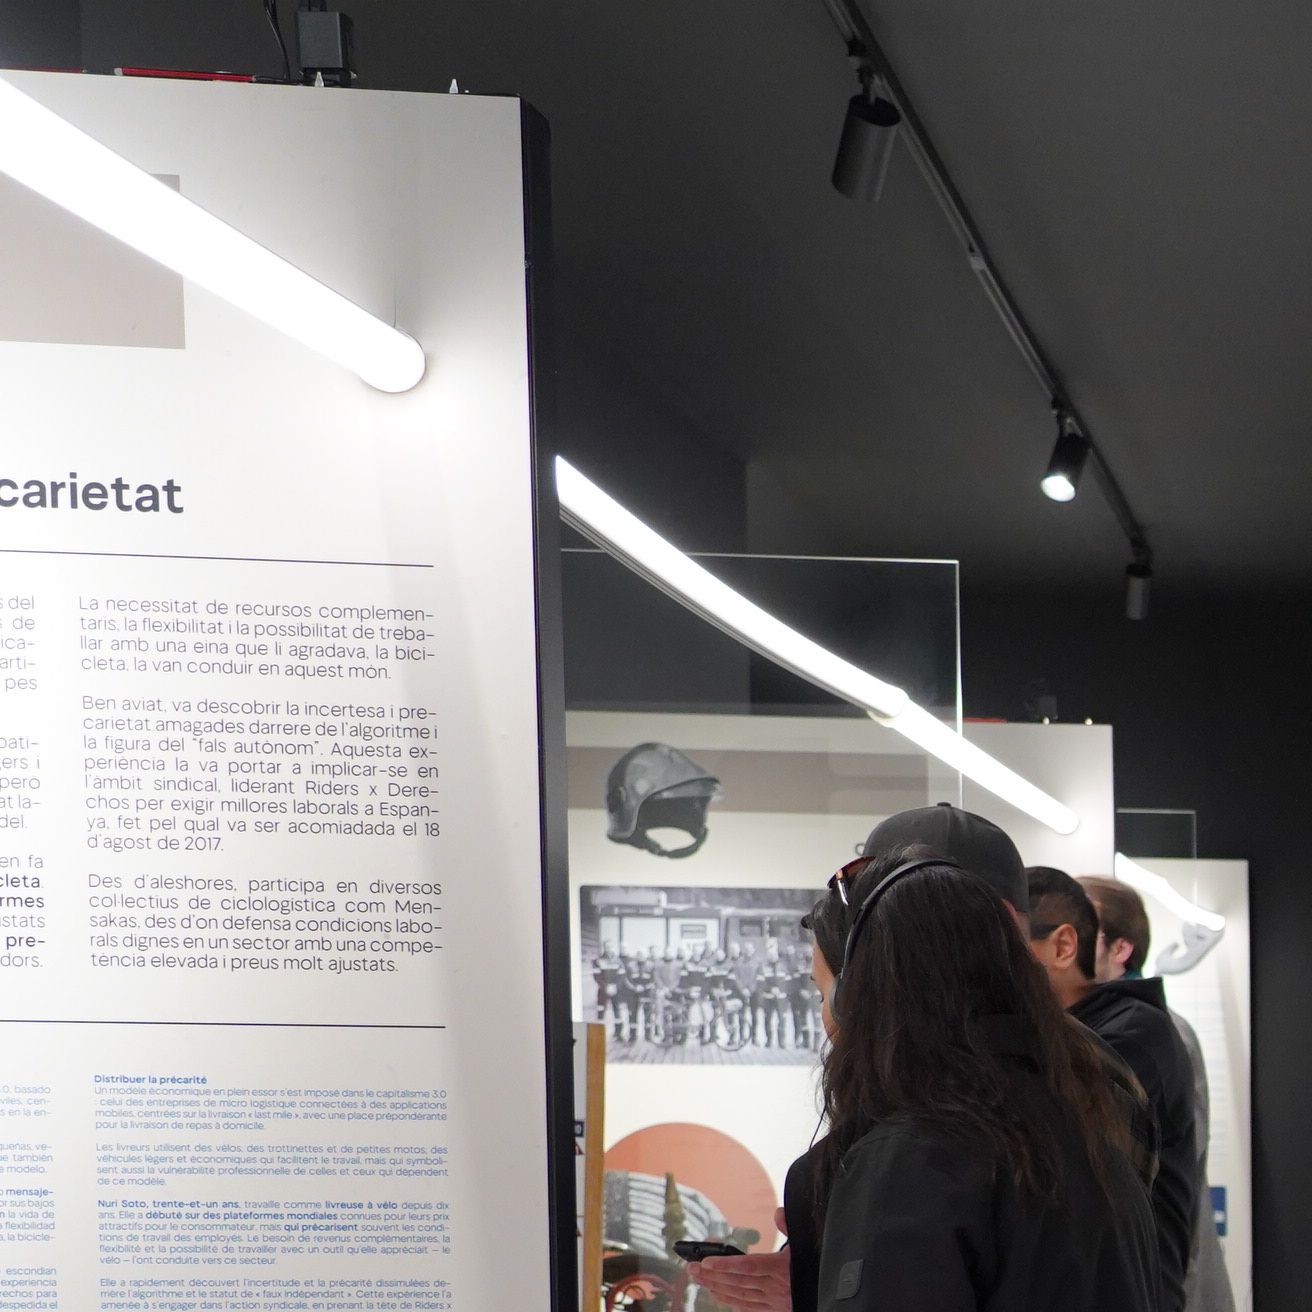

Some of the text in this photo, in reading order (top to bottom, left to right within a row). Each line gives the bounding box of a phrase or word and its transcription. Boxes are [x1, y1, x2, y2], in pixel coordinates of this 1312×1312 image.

[79, 595, 434, 624] La necessitat de recursos complemen-
[12, 617, 35, 630] de
[79, 615, 434, 641] taris, la flexibilitat i la possibilitat de treba-
[80, 635, 435, 661] llar amb una eina que li agradava, la bici-
[80, 655, 129, 672] cleta,
[133, 657, 147, 671] la
[151, 661, 182, 672] van
[186, 658, 253, 674] conduir
[258, 664, 280, 675] en
[284, 662, 344, 680] aquest
[5, 677, 38, 693] pes
[82, 695, 437, 722] Ben aviat, va descobrir la incertesa i pre-
[82, 714, 151, 730] carietat
[155, 716, 245, 736] amagades
[248, 719, 311, 735] darrere
[314, 721, 337, 736] de
[433, 724, 437, 739] i
[83, 735, 96, 749] la
[104, 735, 150, 753] figura
[158, 737, 184, 751] del
[330, 741, 401, 760] Aquesta
[408, 747, 438, 758] ex-
[175, 757, 188, 771] la
[198, 761, 218, 772] va
[227, 759, 282, 776] portar
[291, 763, 301, 774] a
[311, 760, 408, 779] implicar-se
[416, 766, 439, 778] en
[153, 776, 220, 793] sindical,
[231, 778, 295, 793] liderant
[305, 780, 359, 795] Riders
[368, 785, 377, 796] x
[387, 782, 439, 797] Dere-
[85, 794, 439, 820] chos per exigir millores laborals a Espan-
[28, 854, 44, 868] fa
[6, 936, 46, 951] pre-
[94, 1073, 146, 1083] Distribuer
[159, 1075, 207, 1086] précarité
[97, 1198, 117, 1207] Nuri
[121, 1198, 149, 1209] Soto,
[152, 1199, 218, 1208] trente-et-un
[325, 1200, 363, 1209] livreuse
[376, 1200, 398, 1209] vélo
[145, 1210, 182, 1219] débuté
[202, 1210, 221, 1219] des
[223, 1210, 284, 1222] plateformes
[286, 1211, 338, 1220] mondiales
